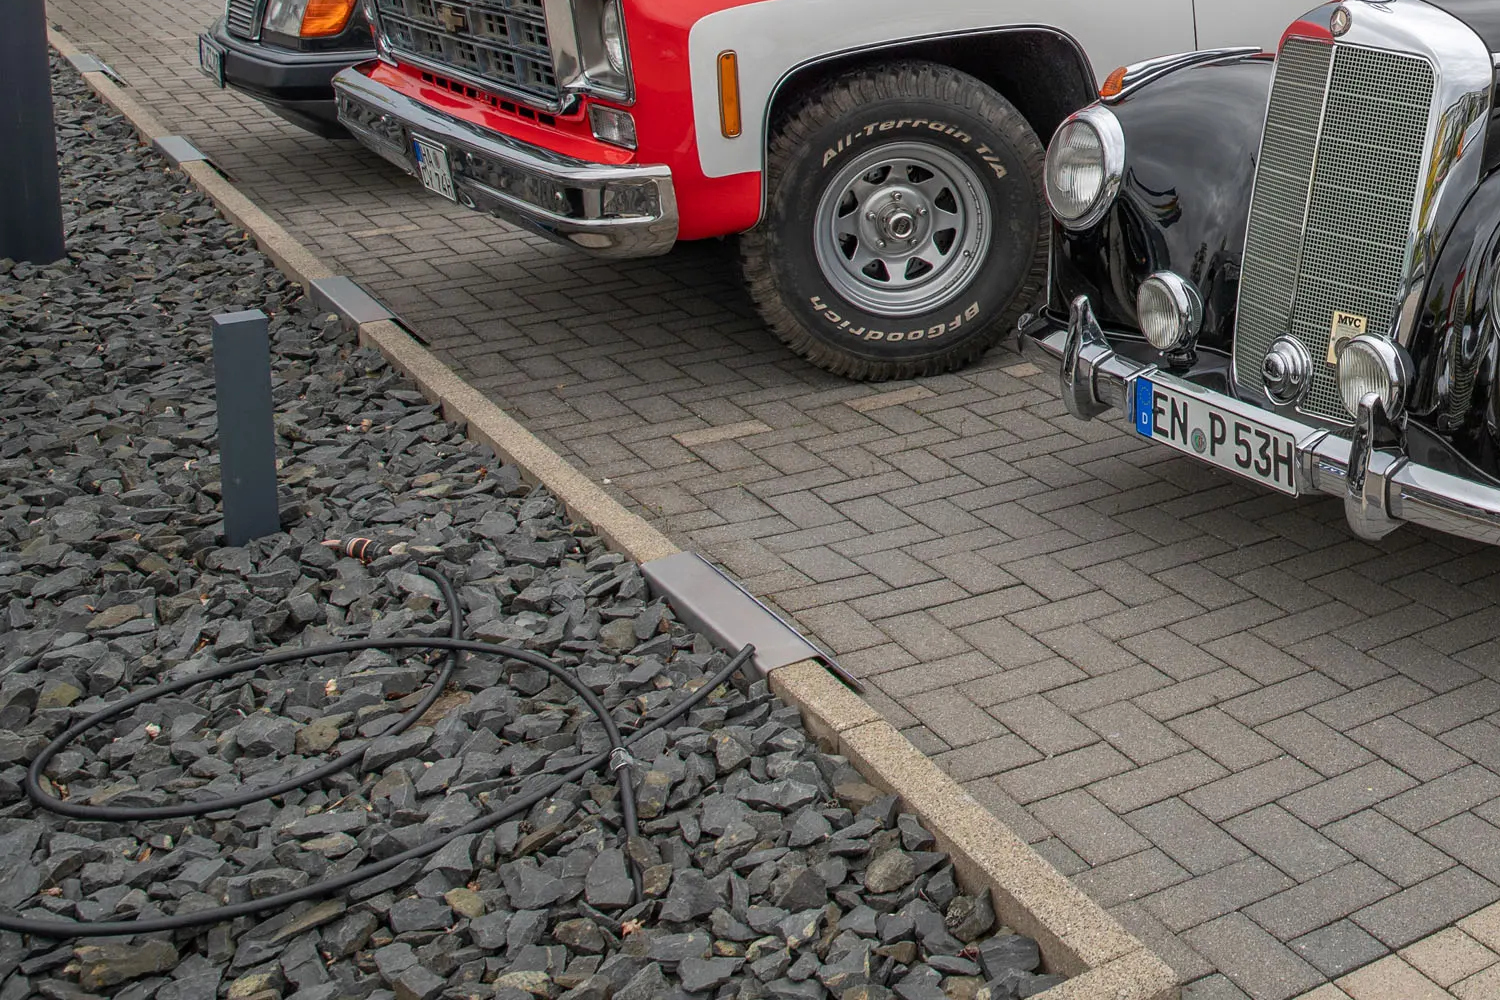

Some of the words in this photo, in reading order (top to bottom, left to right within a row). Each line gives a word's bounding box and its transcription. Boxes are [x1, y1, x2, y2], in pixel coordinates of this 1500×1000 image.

[822, 118, 972, 168] All-Terrain
[976, 142, 1008, 179] T/A
[810, 296, 980, 342] BFGoodrich
[1338, 314, 1361, 328] MVC
[1142, 412, 1147, 425] D
[1153, 390, 1188, 445] EN
[1209, 412, 1226, 456] P
[1235, 422, 1293, 488] 53H
